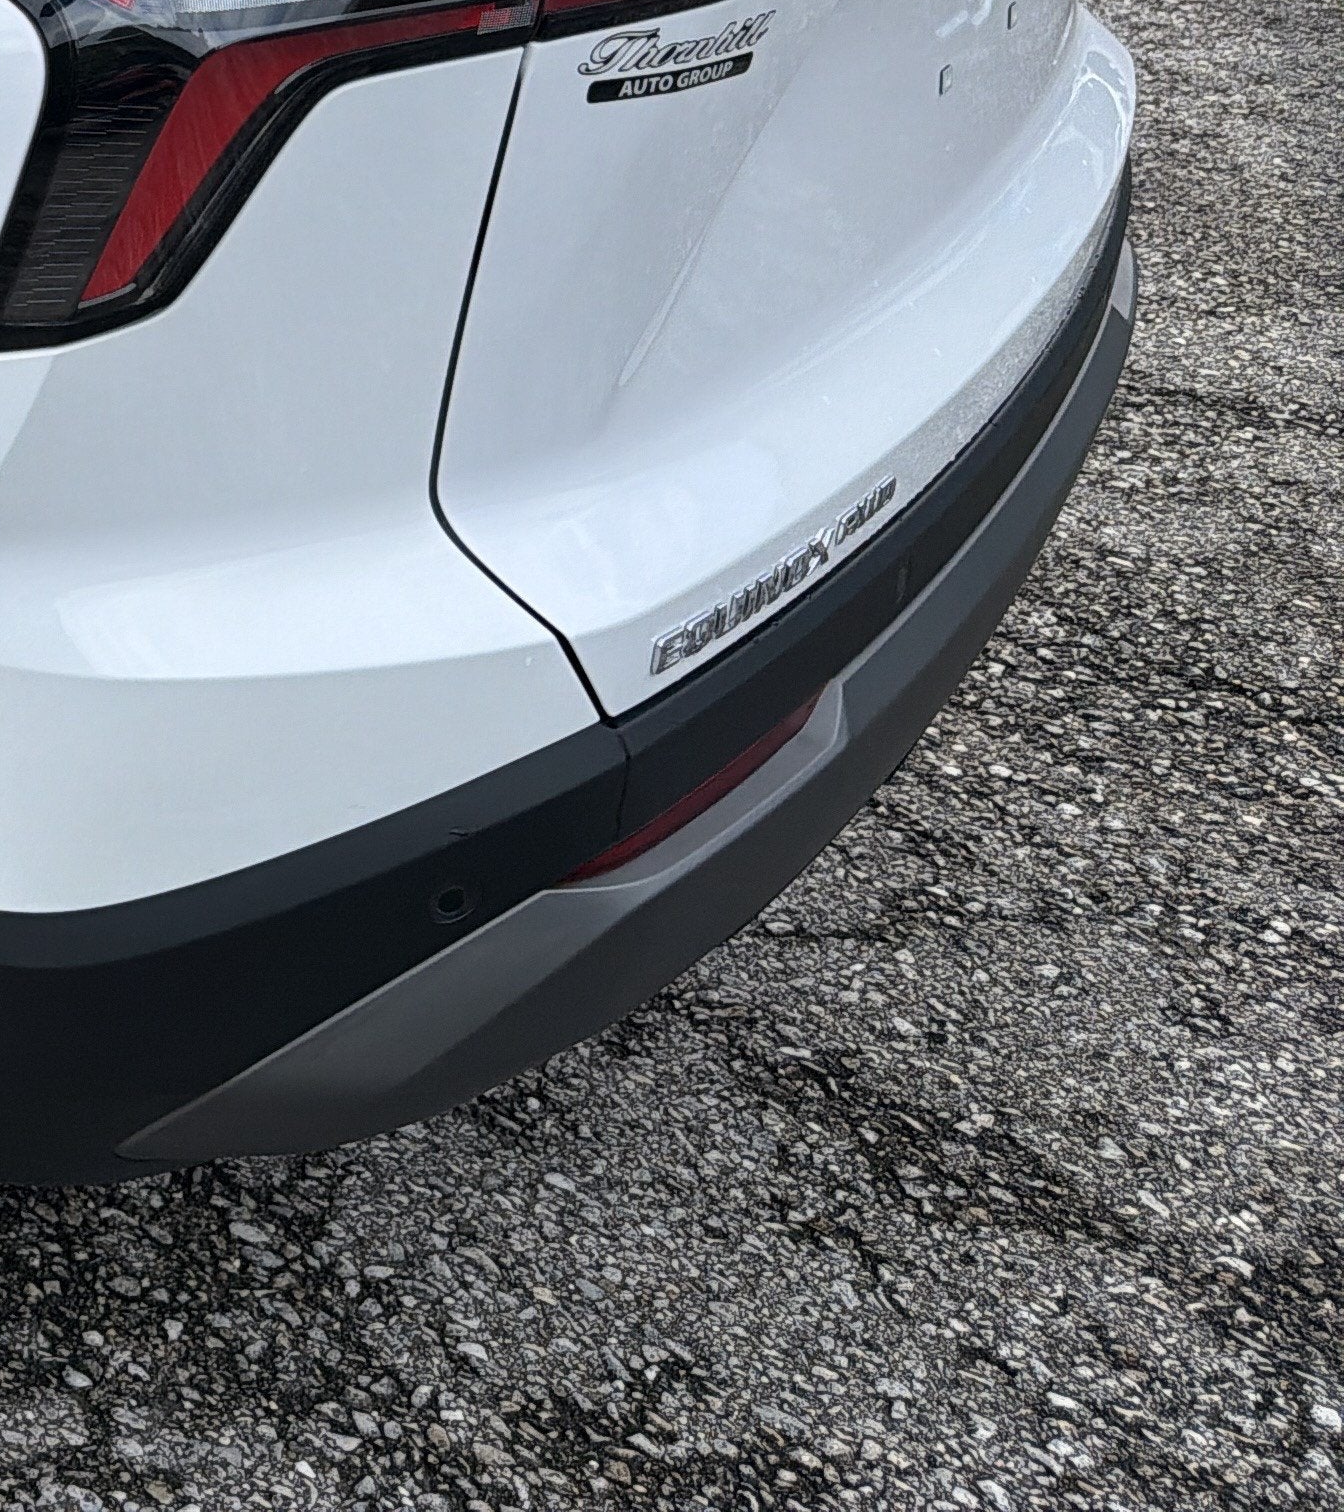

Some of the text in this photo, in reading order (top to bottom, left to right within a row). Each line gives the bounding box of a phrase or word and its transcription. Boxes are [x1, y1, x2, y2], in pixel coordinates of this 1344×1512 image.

[577, 9, 776, 76] Thornhill
[618, 61, 734, 98] AUTO GROUP
